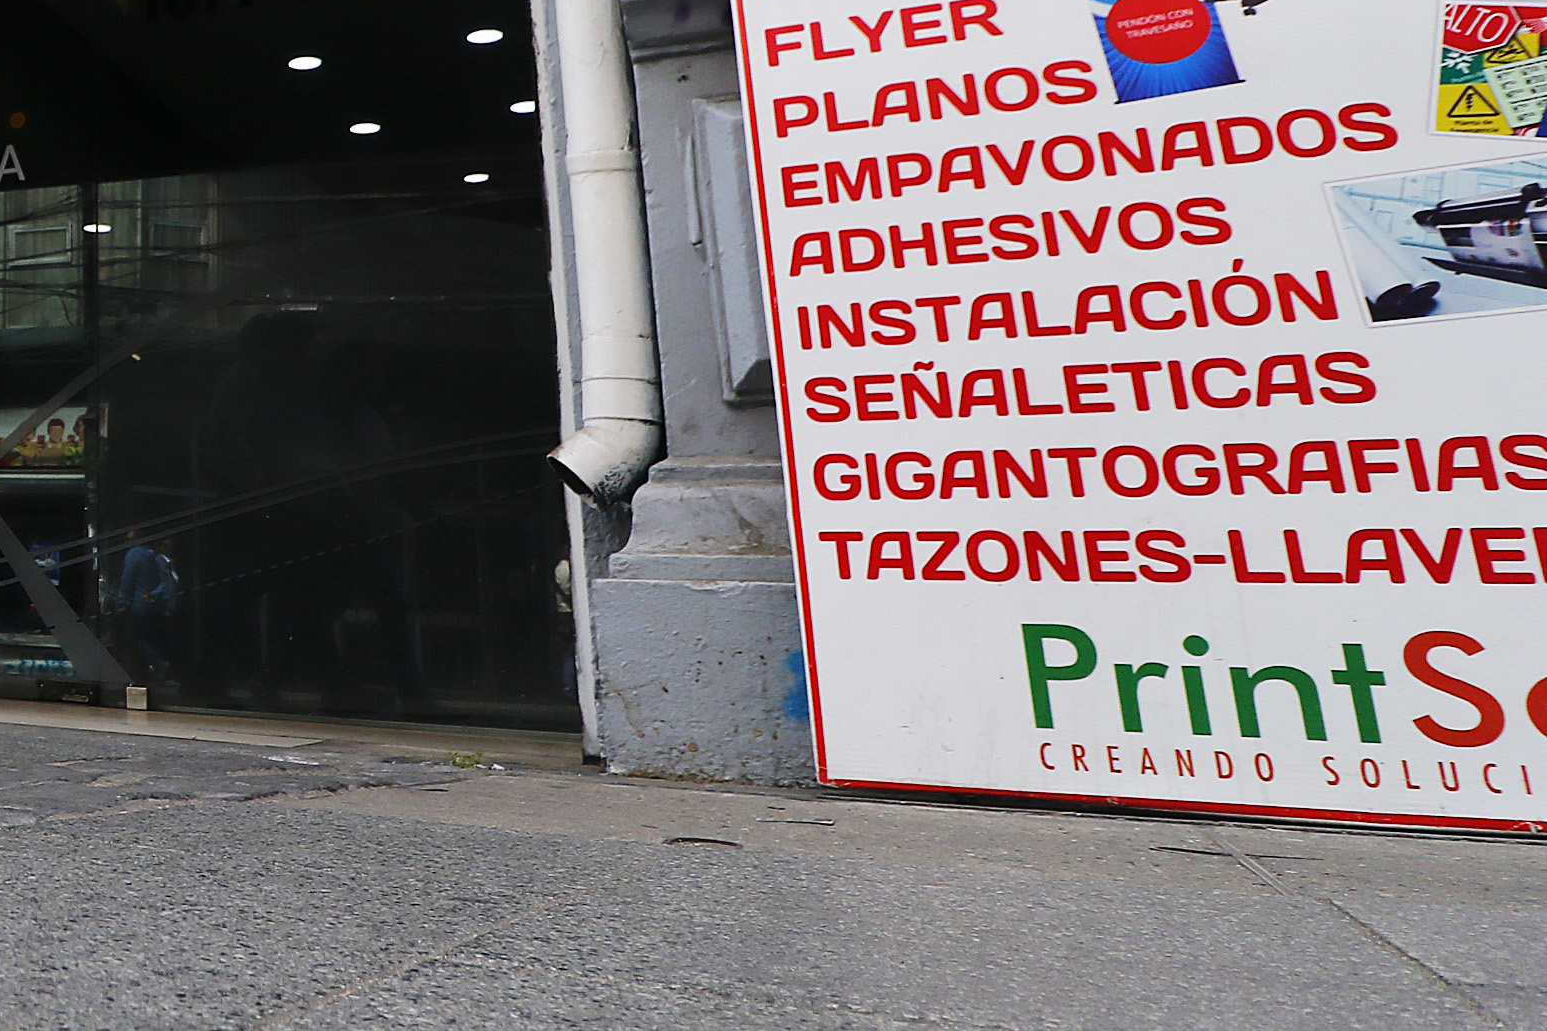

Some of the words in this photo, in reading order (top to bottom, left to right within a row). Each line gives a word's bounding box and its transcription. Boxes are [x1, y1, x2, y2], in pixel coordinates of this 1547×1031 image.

[774, 60, 1097, 138] PLANOS
[782, 102, 1399, 208] EMPAVONADOS
[789, 198, 1232, 277] ADHESIVOS
[798, 259, 1338, 350] INSTALACIÓN
[805, 352, 1376, 422] SEÑALETICAS
[813, 434, 1547, 501] GIGANTOGRAFIAS
[819, 527, 1547, 585] TAZONES-LLAVE
[1022, 623, 1547, 747] PrintS
[1040, 743, 1274, 782] CREANDO
[1322, 756, 1532, 794] SOLUCI
